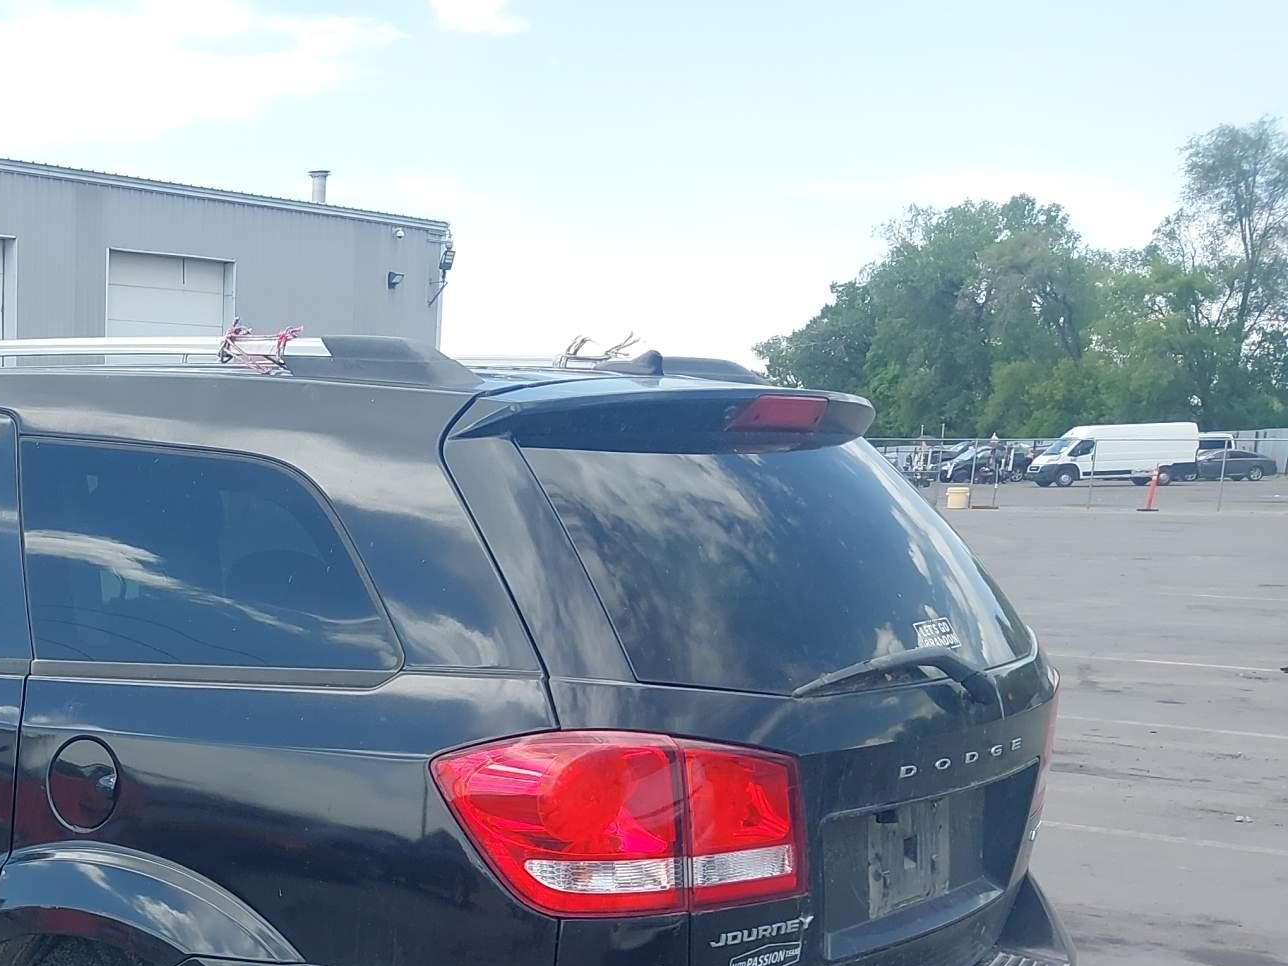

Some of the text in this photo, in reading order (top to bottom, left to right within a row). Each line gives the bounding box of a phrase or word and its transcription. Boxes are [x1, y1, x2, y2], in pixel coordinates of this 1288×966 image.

[938, 622, 950, 633] GO
[899, 737, 1023, 778] DODGE
[709, 915, 815, 948] JOURNEY
